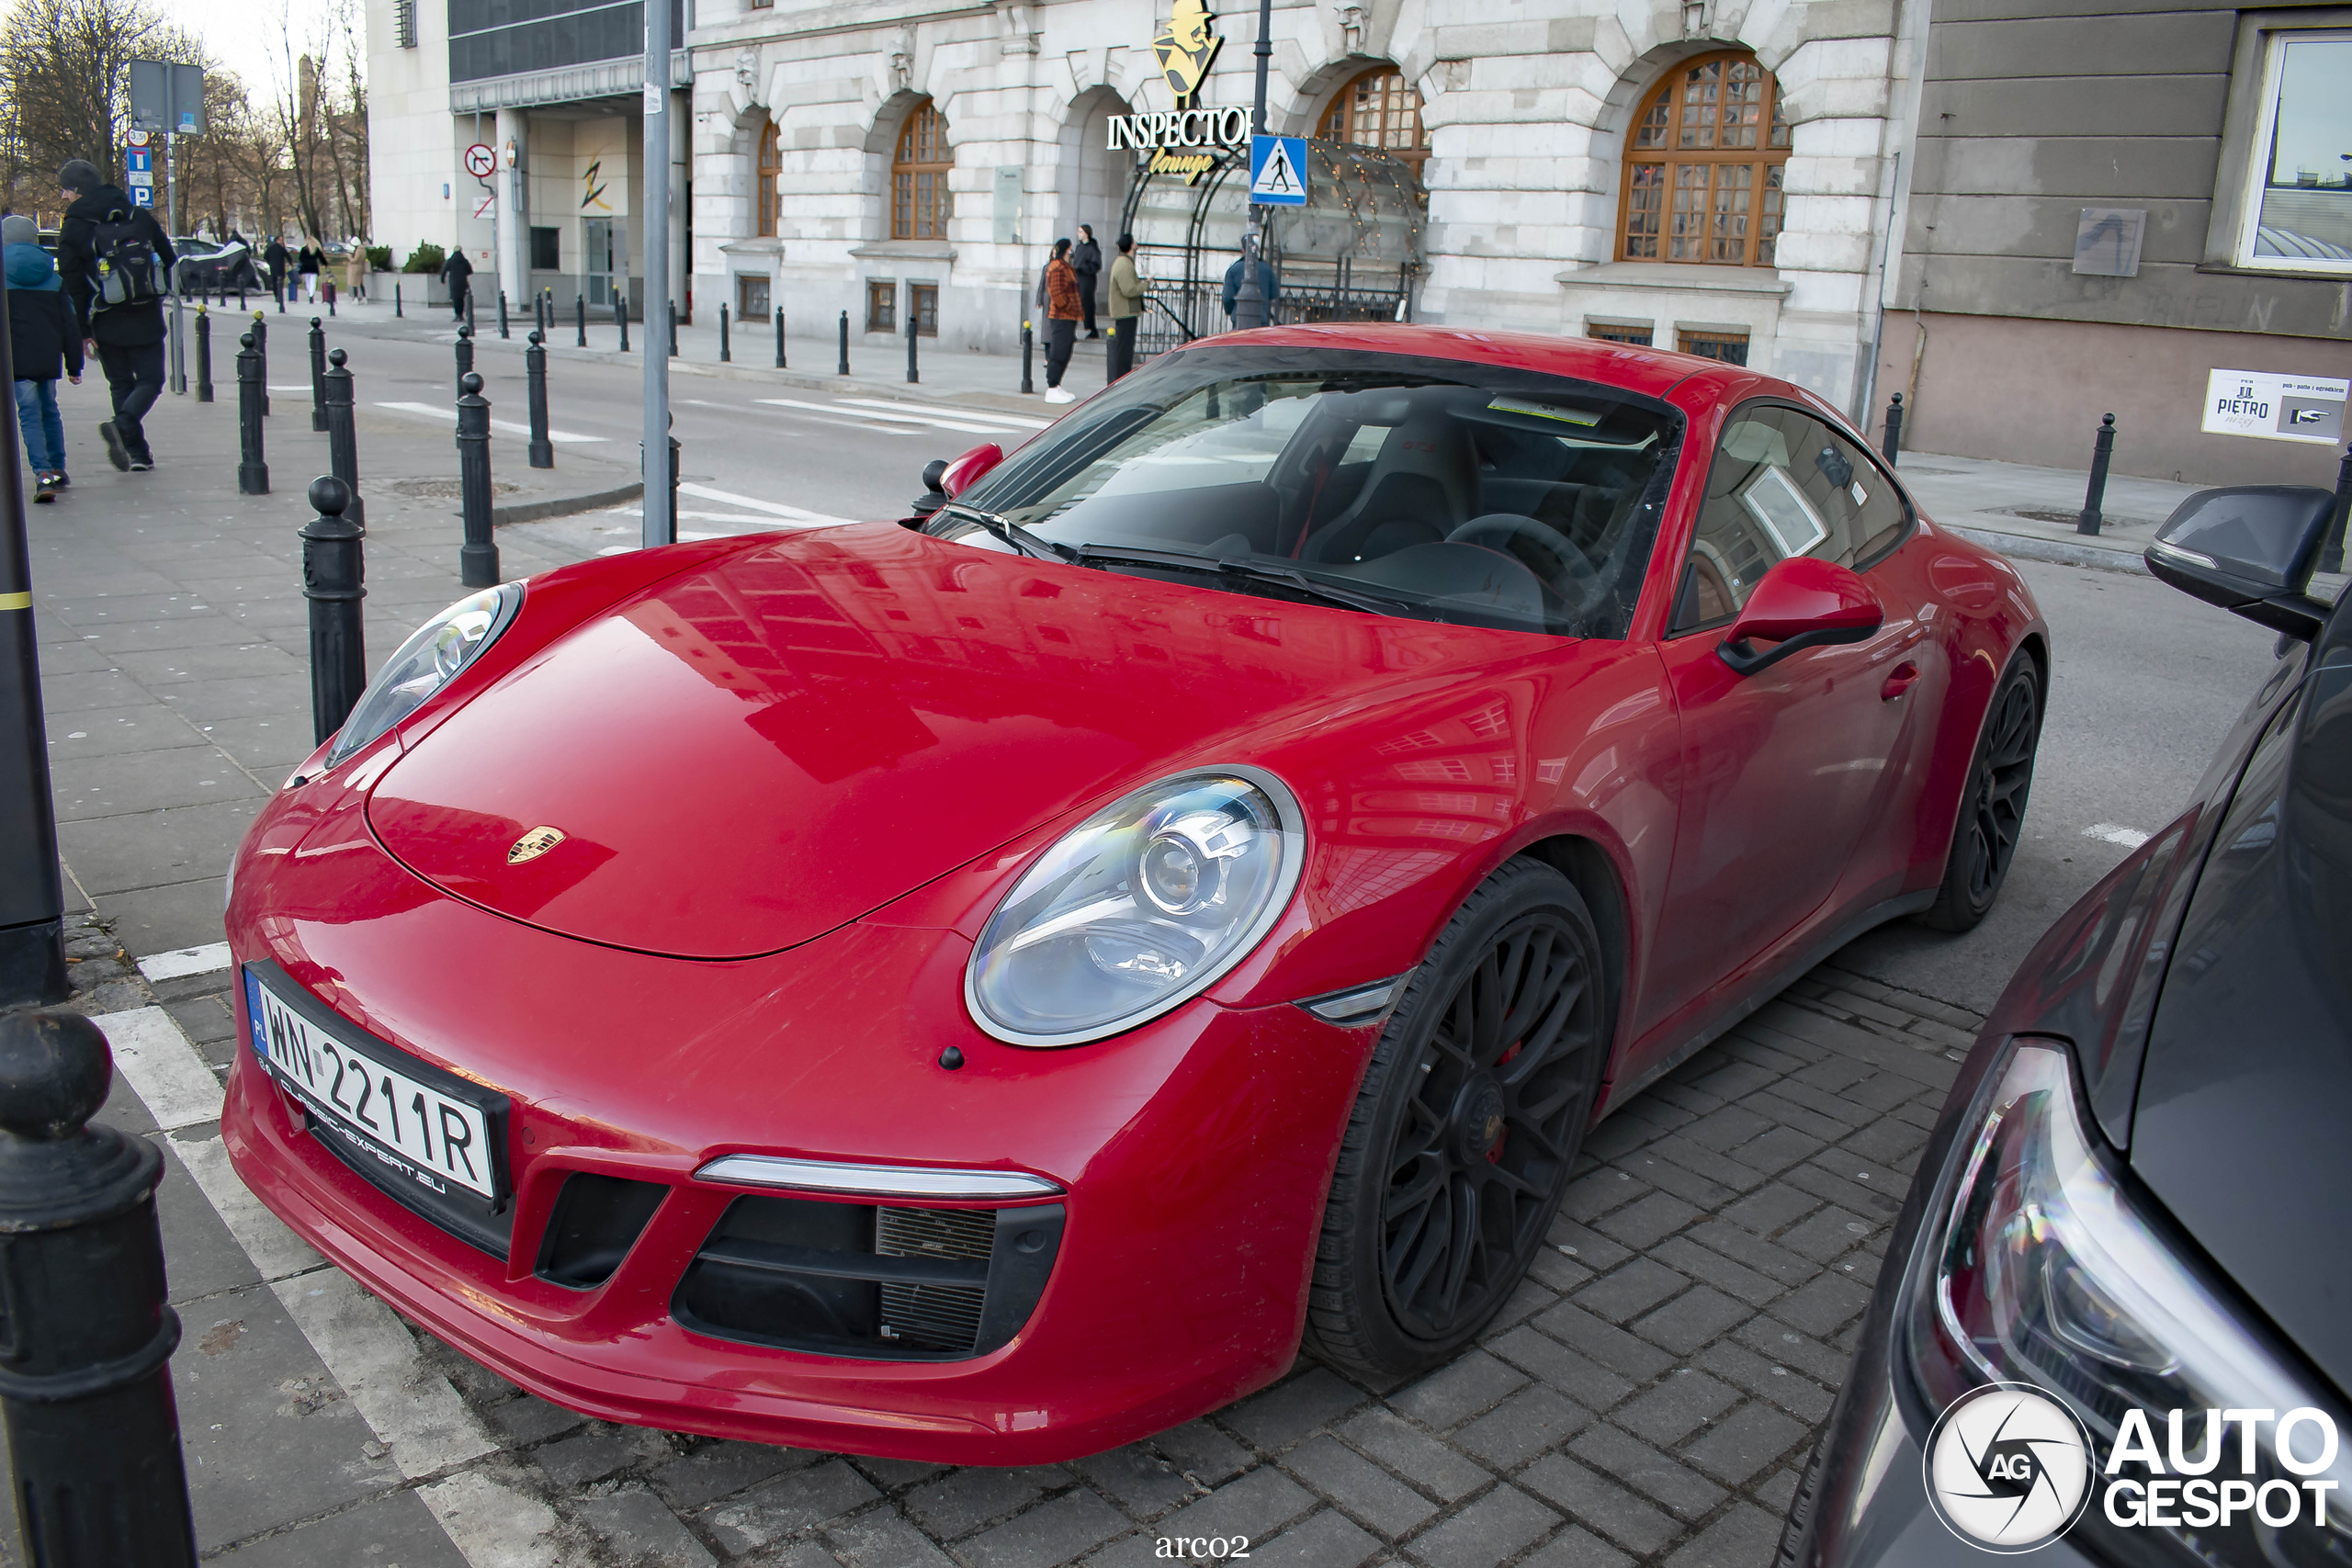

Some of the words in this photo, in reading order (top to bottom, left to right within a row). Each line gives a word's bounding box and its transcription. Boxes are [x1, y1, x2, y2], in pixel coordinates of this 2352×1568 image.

[1149, 146, 1214, 186] lounge
[135, 187, 150, 207] P
[2217, 399, 2268, 419] PIĘTRO
[254, 1019, 266, 1043] PL
[265, 993, 315, 1089] WN
[322, 1042, 480, 1183] 2211R
[280, 1078, 447, 1194] CLASSIC-EXPERT.EU
